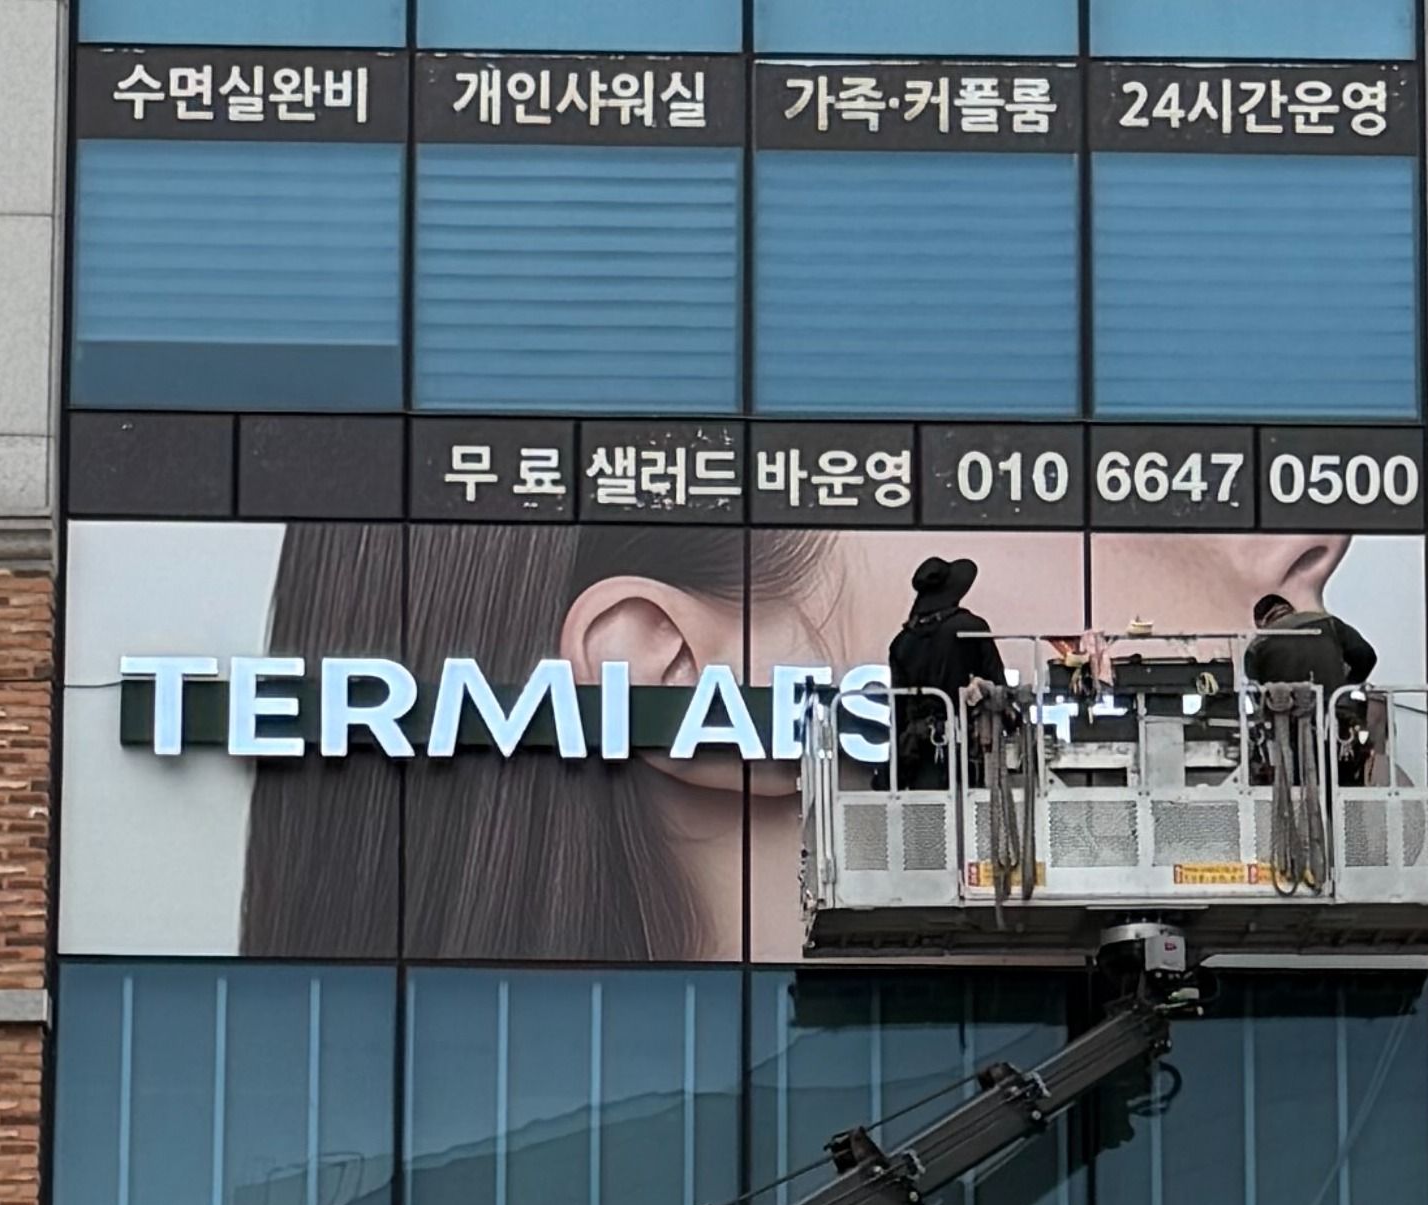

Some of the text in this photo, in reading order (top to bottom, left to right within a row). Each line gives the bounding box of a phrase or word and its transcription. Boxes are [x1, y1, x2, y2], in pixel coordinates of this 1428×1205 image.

[113, 64, 368, 123] 수면실완비
[453, 68, 706, 127] 개인샤워실
[1118, 79, 1388, 137] 24시간운영
[957, 451, 1068, 503] 010
[1096, 451, 1245, 503] 6647
[1270, 453, 1420, 505] 0500
[119, 655, 631, 759] TERMI
